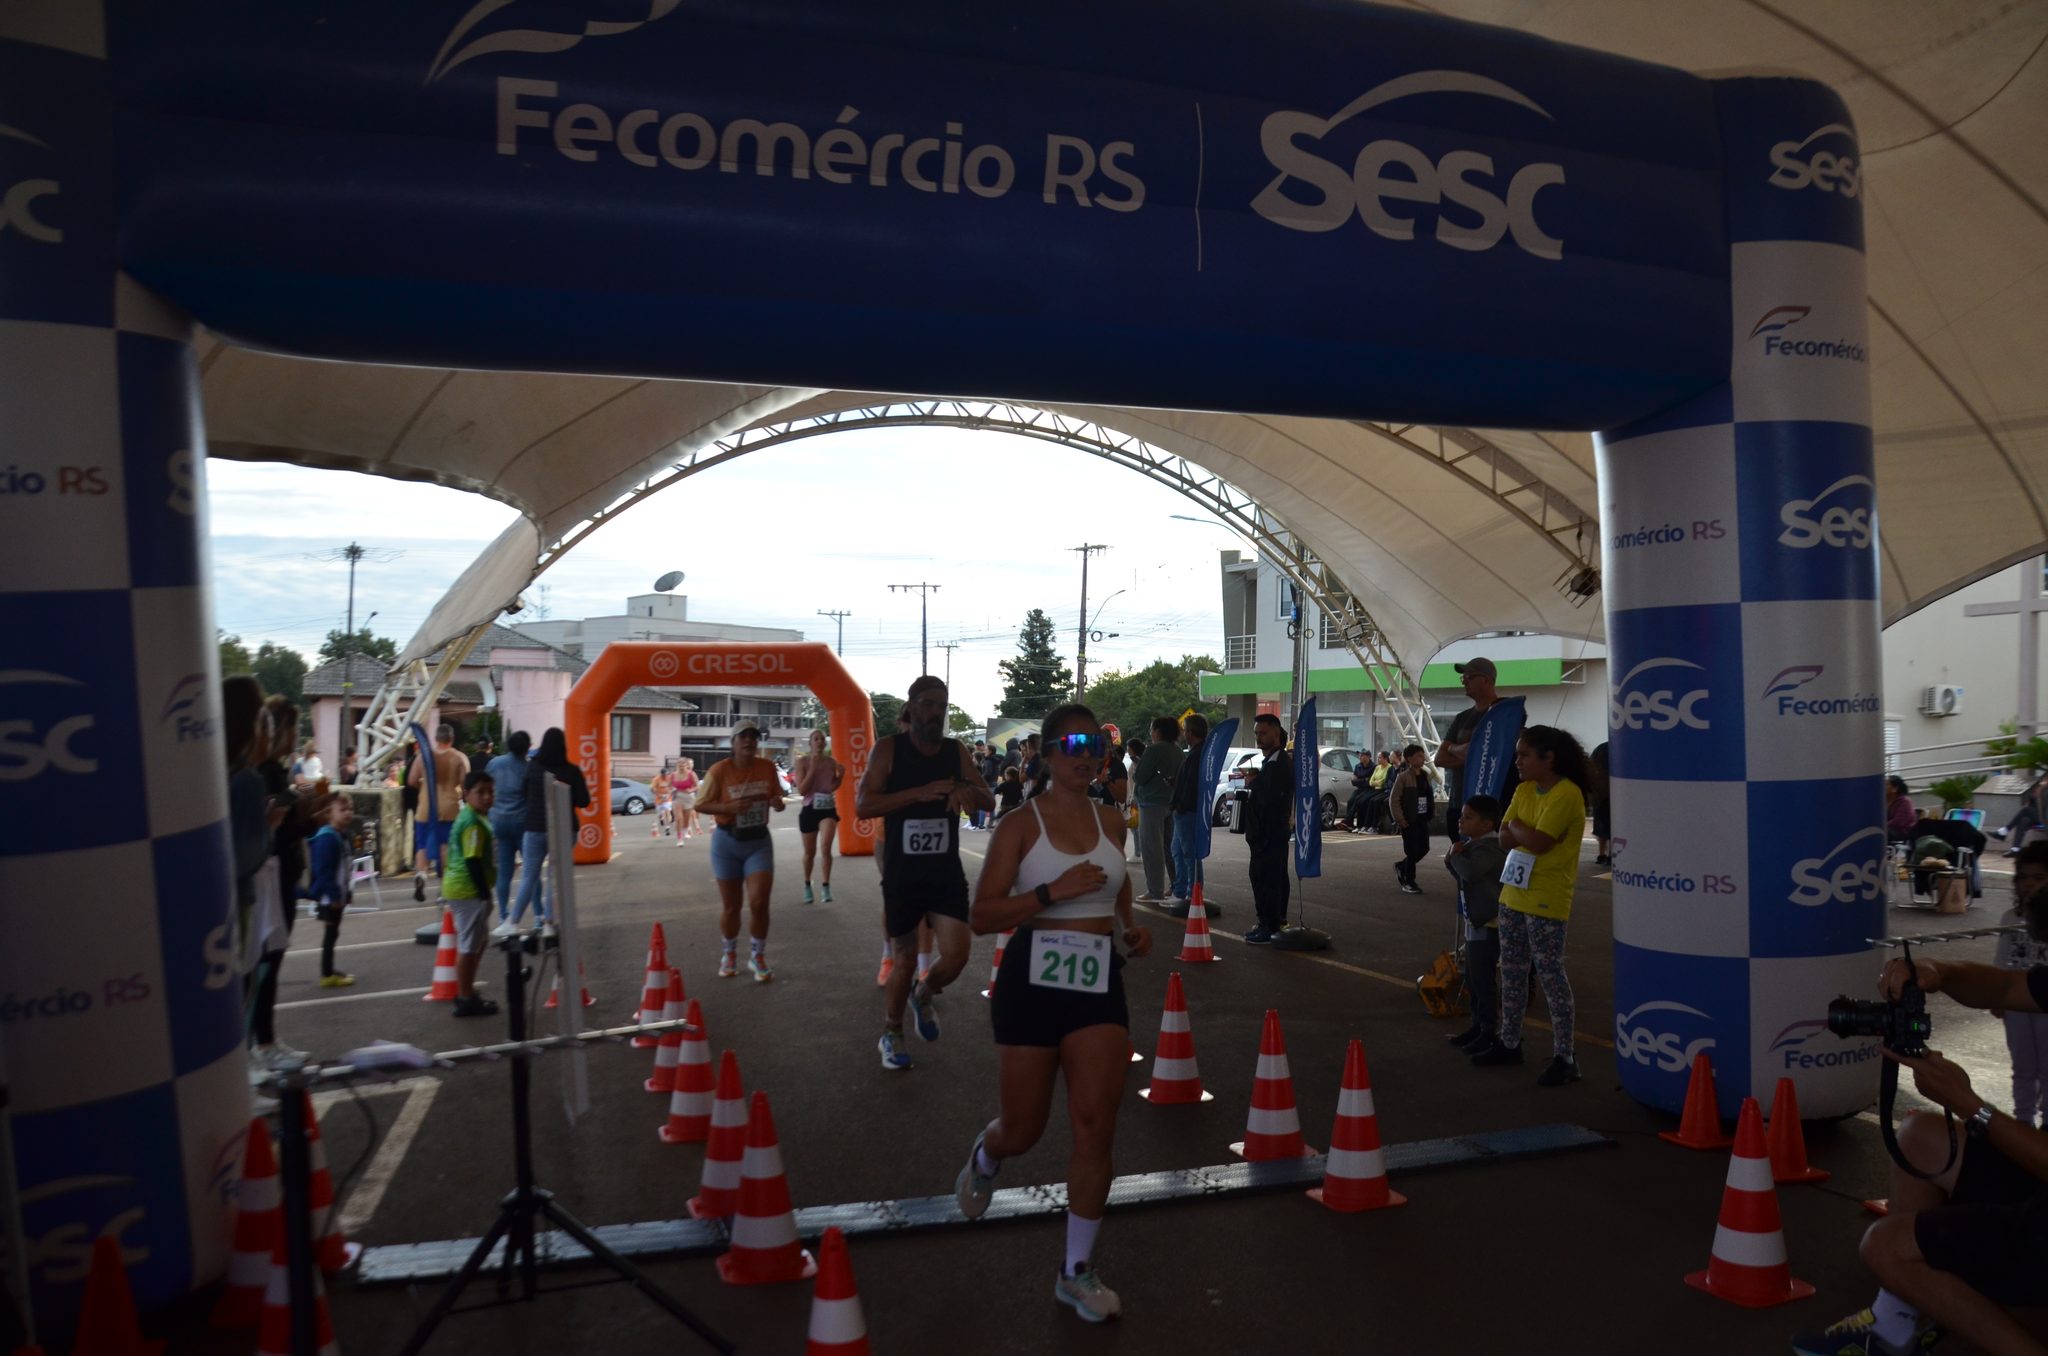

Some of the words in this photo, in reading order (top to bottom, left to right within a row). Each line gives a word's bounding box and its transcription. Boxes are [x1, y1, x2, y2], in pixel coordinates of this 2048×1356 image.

[496, 76, 1015, 198] Fecomércio
[1042, 132, 1147, 212] RS
[1250, 110, 1566, 260] Sesc
[59, 465, 110, 496] RS
[1692, 519, 1727, 541] RS
[1777, 498, 1872, 550] Ses
[687, 653, 794, 674] CRESOL
[909, 832, 944, 852] 627
[1702, 874, 1737, 894] RS
[1041, 949, 1100, 988] 219
[103, 972, 150, 1006] RS
